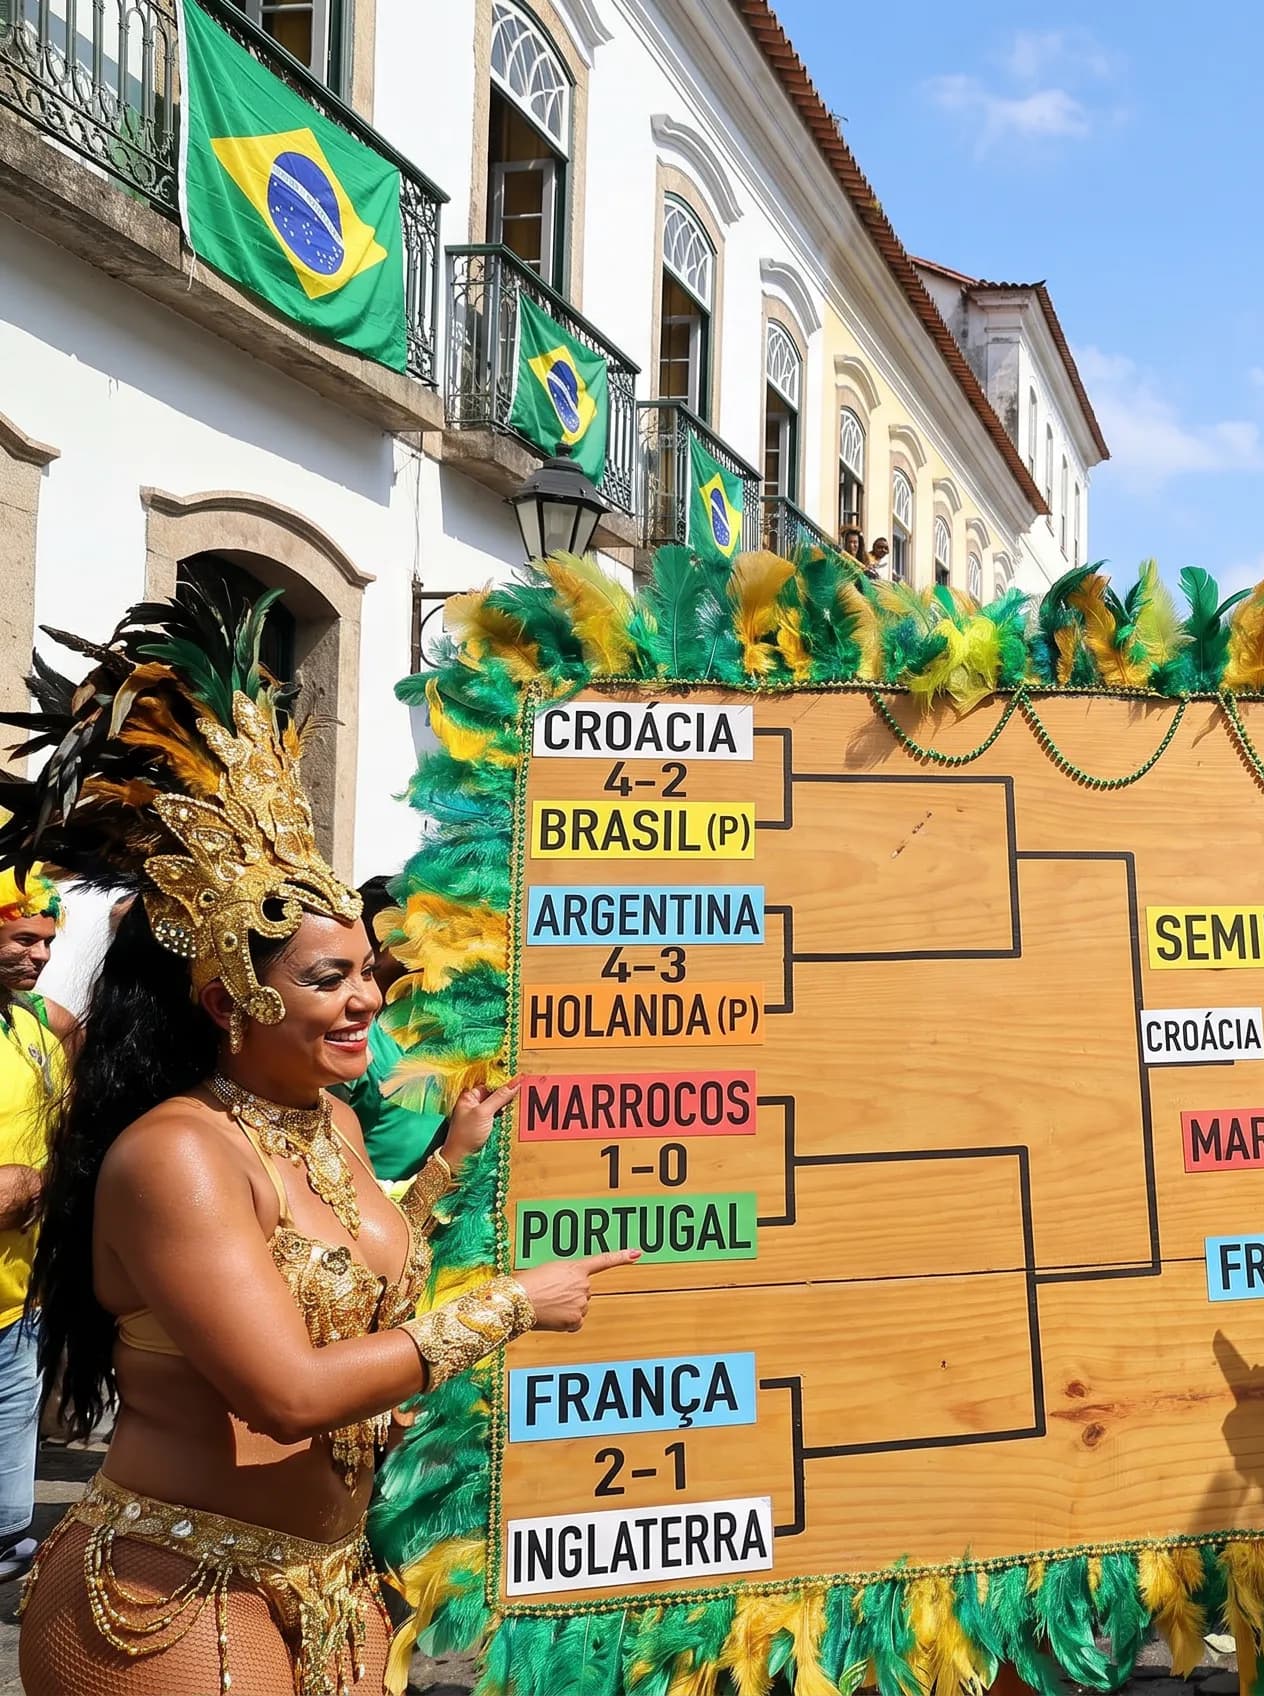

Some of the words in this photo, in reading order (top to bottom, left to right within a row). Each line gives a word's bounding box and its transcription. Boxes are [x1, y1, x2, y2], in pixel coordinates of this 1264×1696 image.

[544, 701, 737, 753] CROÁCIA
[533, 894, 760, 936] ARGENTINA
[1145, 1011, 1262, 1052] CROÁCIA
[527, 1080, 750, 1131] MARROCOS
[521, 1202, 752, 1259] PORTUGAL
[526, 1361, 739, 1429] FRANÇA
[513, 1509, 768, 1585] INGLATERRA
